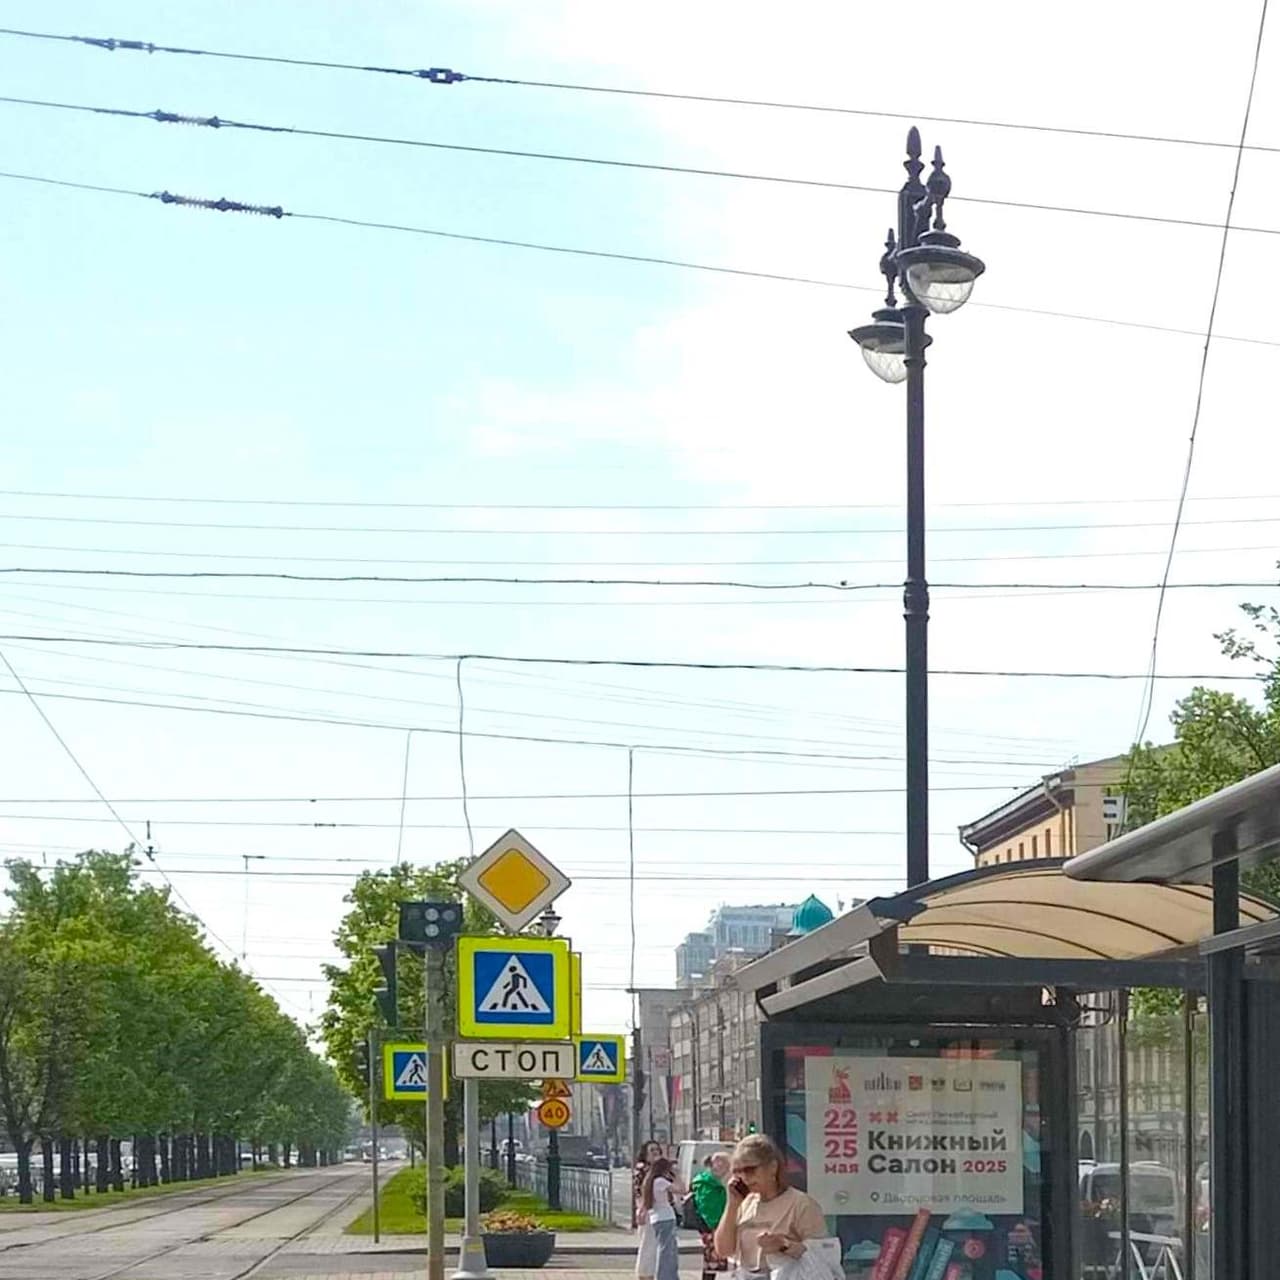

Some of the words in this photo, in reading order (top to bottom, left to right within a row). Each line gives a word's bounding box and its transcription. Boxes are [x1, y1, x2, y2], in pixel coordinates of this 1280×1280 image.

[471, 1049, 559, 1072] СТОП
[543, 1107, 565, 1119] 40
[824, 1109, 858, 1129] 22
[824, 1140, 858, 1158] 25
[868, 1129, 1007, 1151] Книжный
[824, 1163, 859, 1174] мая
[868, 1154, 956, 1174] Салон
[963, 1160, 1007, 1173] 2025
